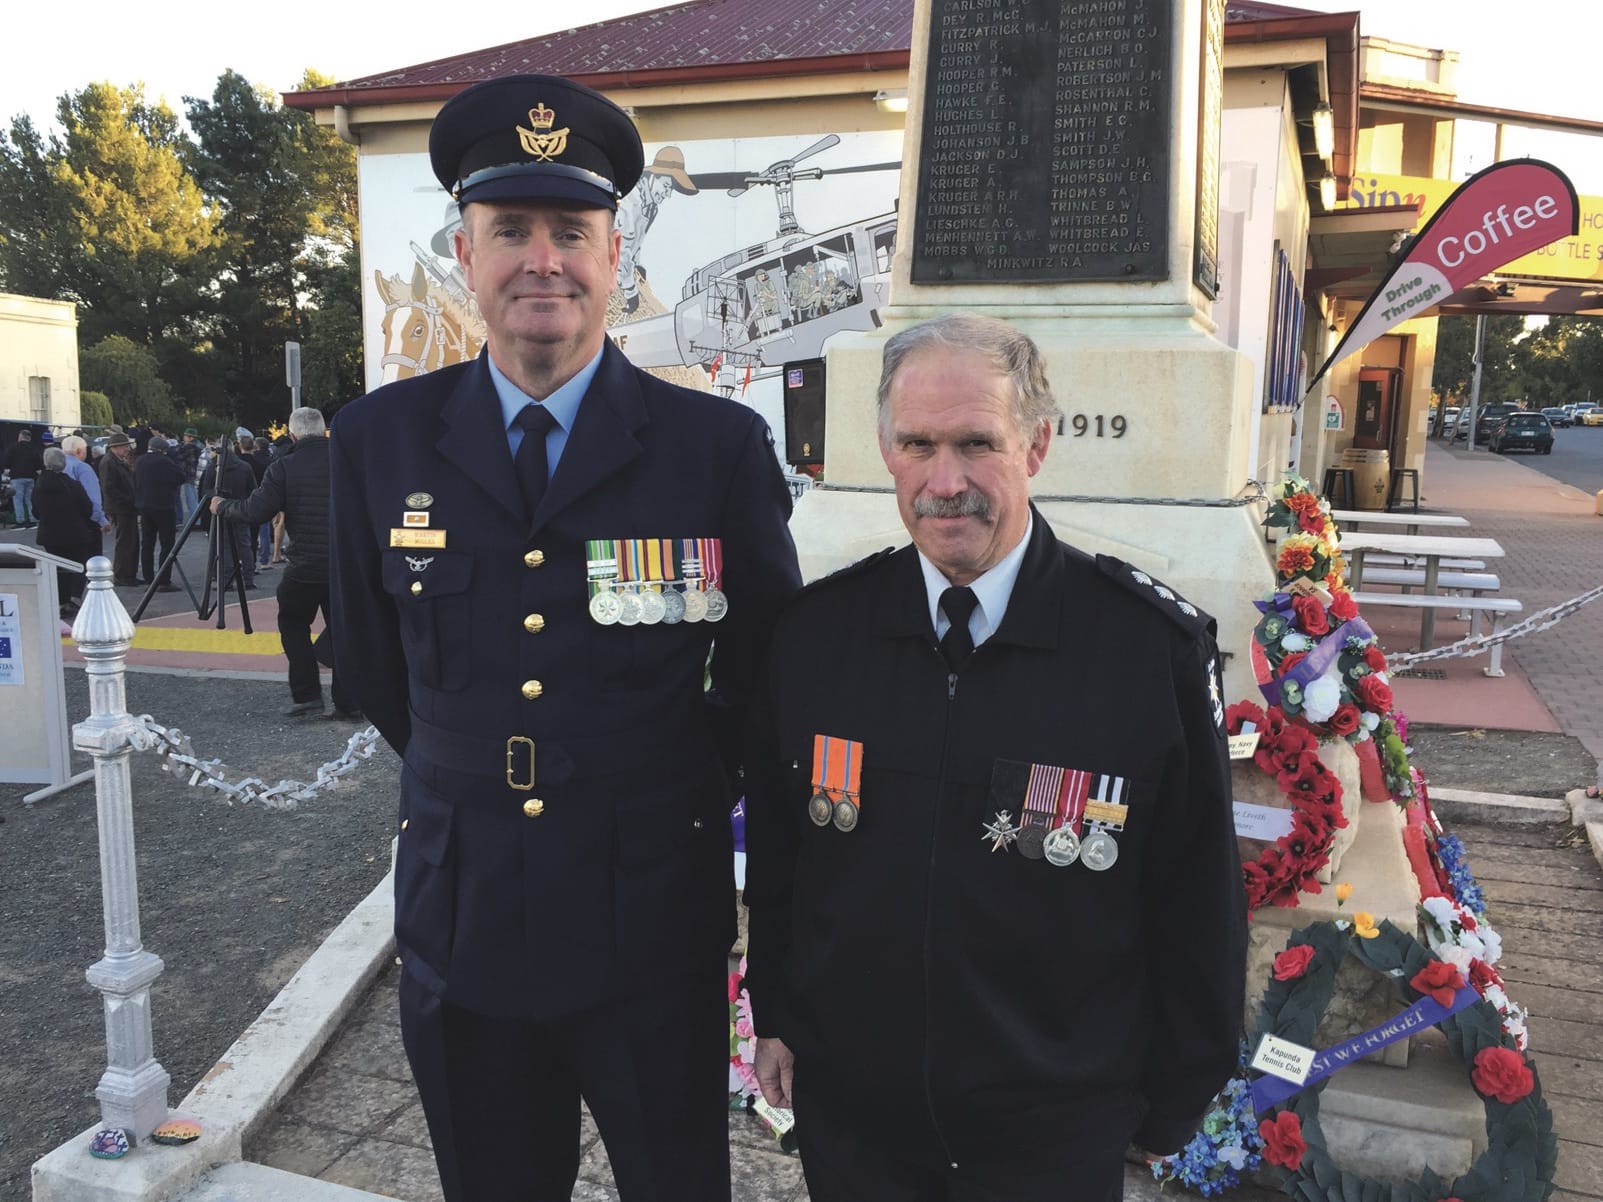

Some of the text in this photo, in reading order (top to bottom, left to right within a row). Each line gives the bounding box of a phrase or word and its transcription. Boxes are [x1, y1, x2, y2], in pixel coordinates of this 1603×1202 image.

[1060, 0, 1126, 15] McMAHON
[942, 14, 966, 26] DEY
[1060, 15, 1125, 30] McMAHON
[941, 23, 1020, 39] FITZPATRICK
[1059, 28, 1130, 44] McCARRON
[1058, 44, 1113, 58] NERLICH
[1057, 58, 1122, 73] PATERSON
[938, 68, 985, 81] HOOPER
[1056, 71, 1131, 87] ROBERTSON
[937, 81, 984, 95] HOOPER
[1056, 86, 1133, 101] ROSENTHAL
[936, 96, 978, 109] HAWKE
[1055, 101, 1118, 115] SHANNON
[934, 122, 1002, 136] HOLTHOUSE
[1054, 116, 1096, 129] SMITH
[932, 137, 1000, 150] JOHANSON
[1054, 130, 1096, 144] SMITH
[931, 150, 991, 162] JACKSON
[1052, 144, 1094, 156] SCOTT
[1051, 158, 1116, 171] SAMPSON
[1051, 172, 1122, 185] THOMPSON
[1050, 187, 1107, 199] THOMAS
[1050, 213, 1128, 226] WHITBREAD
[1049, 227, 1129, 240] WHITBREAD
[1437, 194, 1559, 268] Coffee
[924, 246, 968, 257] MOBBS
[1048, 242, 1118, 254] WOOLCOCK
[987, 257, 1054, 269] MINKWITZ
[1384, 275, 1423, 304] Drive
[1381, 281, 1442, 322] Through
[1056, 414, 1128, 438] 1919
[1270, 1046, 1301, 1063] Kapunda
[1262, 1054, 1302, 1075] Tennis Club
